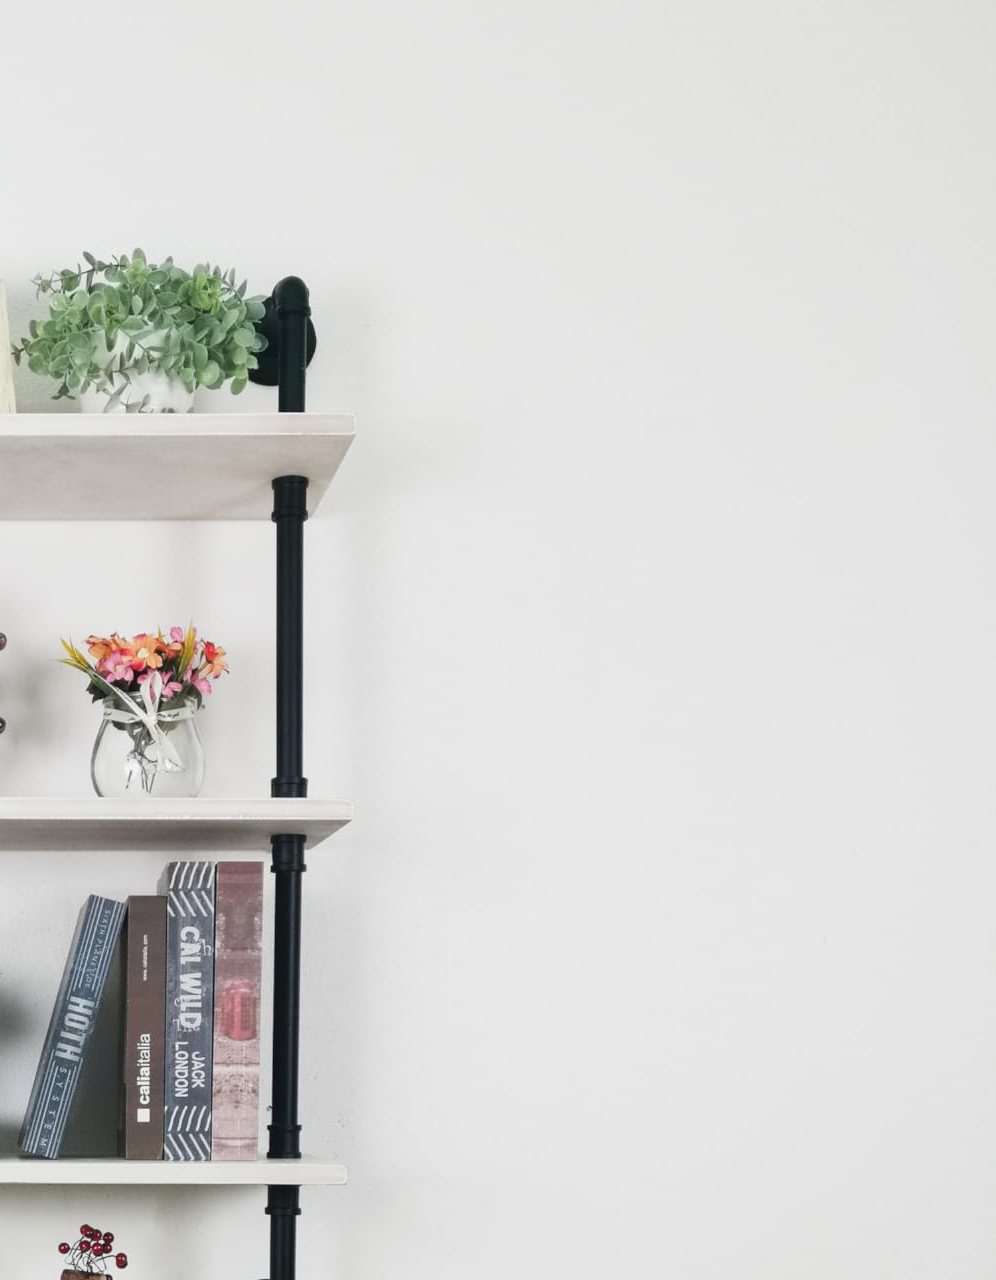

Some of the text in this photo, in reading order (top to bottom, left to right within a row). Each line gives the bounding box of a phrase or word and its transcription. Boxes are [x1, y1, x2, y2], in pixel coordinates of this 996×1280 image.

[179, 972, 202, 1028] WILD
[54, 996, 95, 1062] HOTH
[136, 1033, 150, 1105] caliaitalia
[174, 1041, 188, 1097] LONDON
[191, 1051, 205, 1089] JACK
